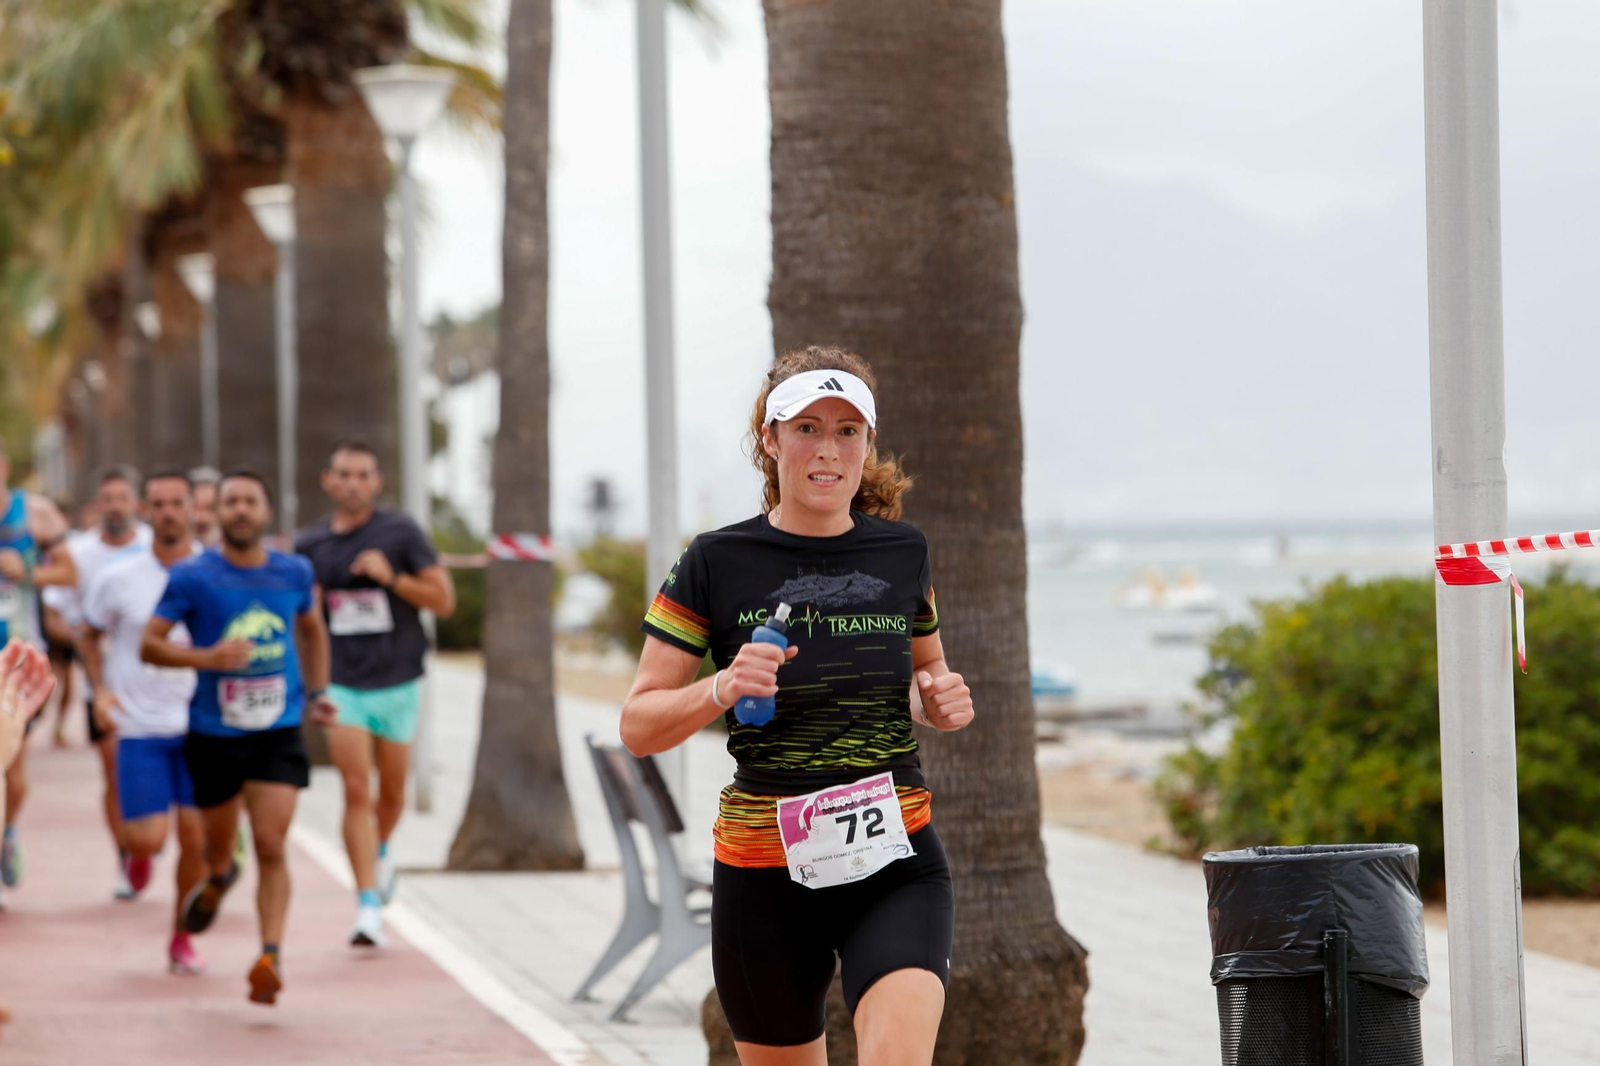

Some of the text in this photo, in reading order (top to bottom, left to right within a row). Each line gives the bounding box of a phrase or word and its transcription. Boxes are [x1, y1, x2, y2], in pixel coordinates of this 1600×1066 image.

[738, 608, 907, 632] MC TRAINING
[835, 807, 886, 845] 72
[812, 855, 833, 863] BURGOS
